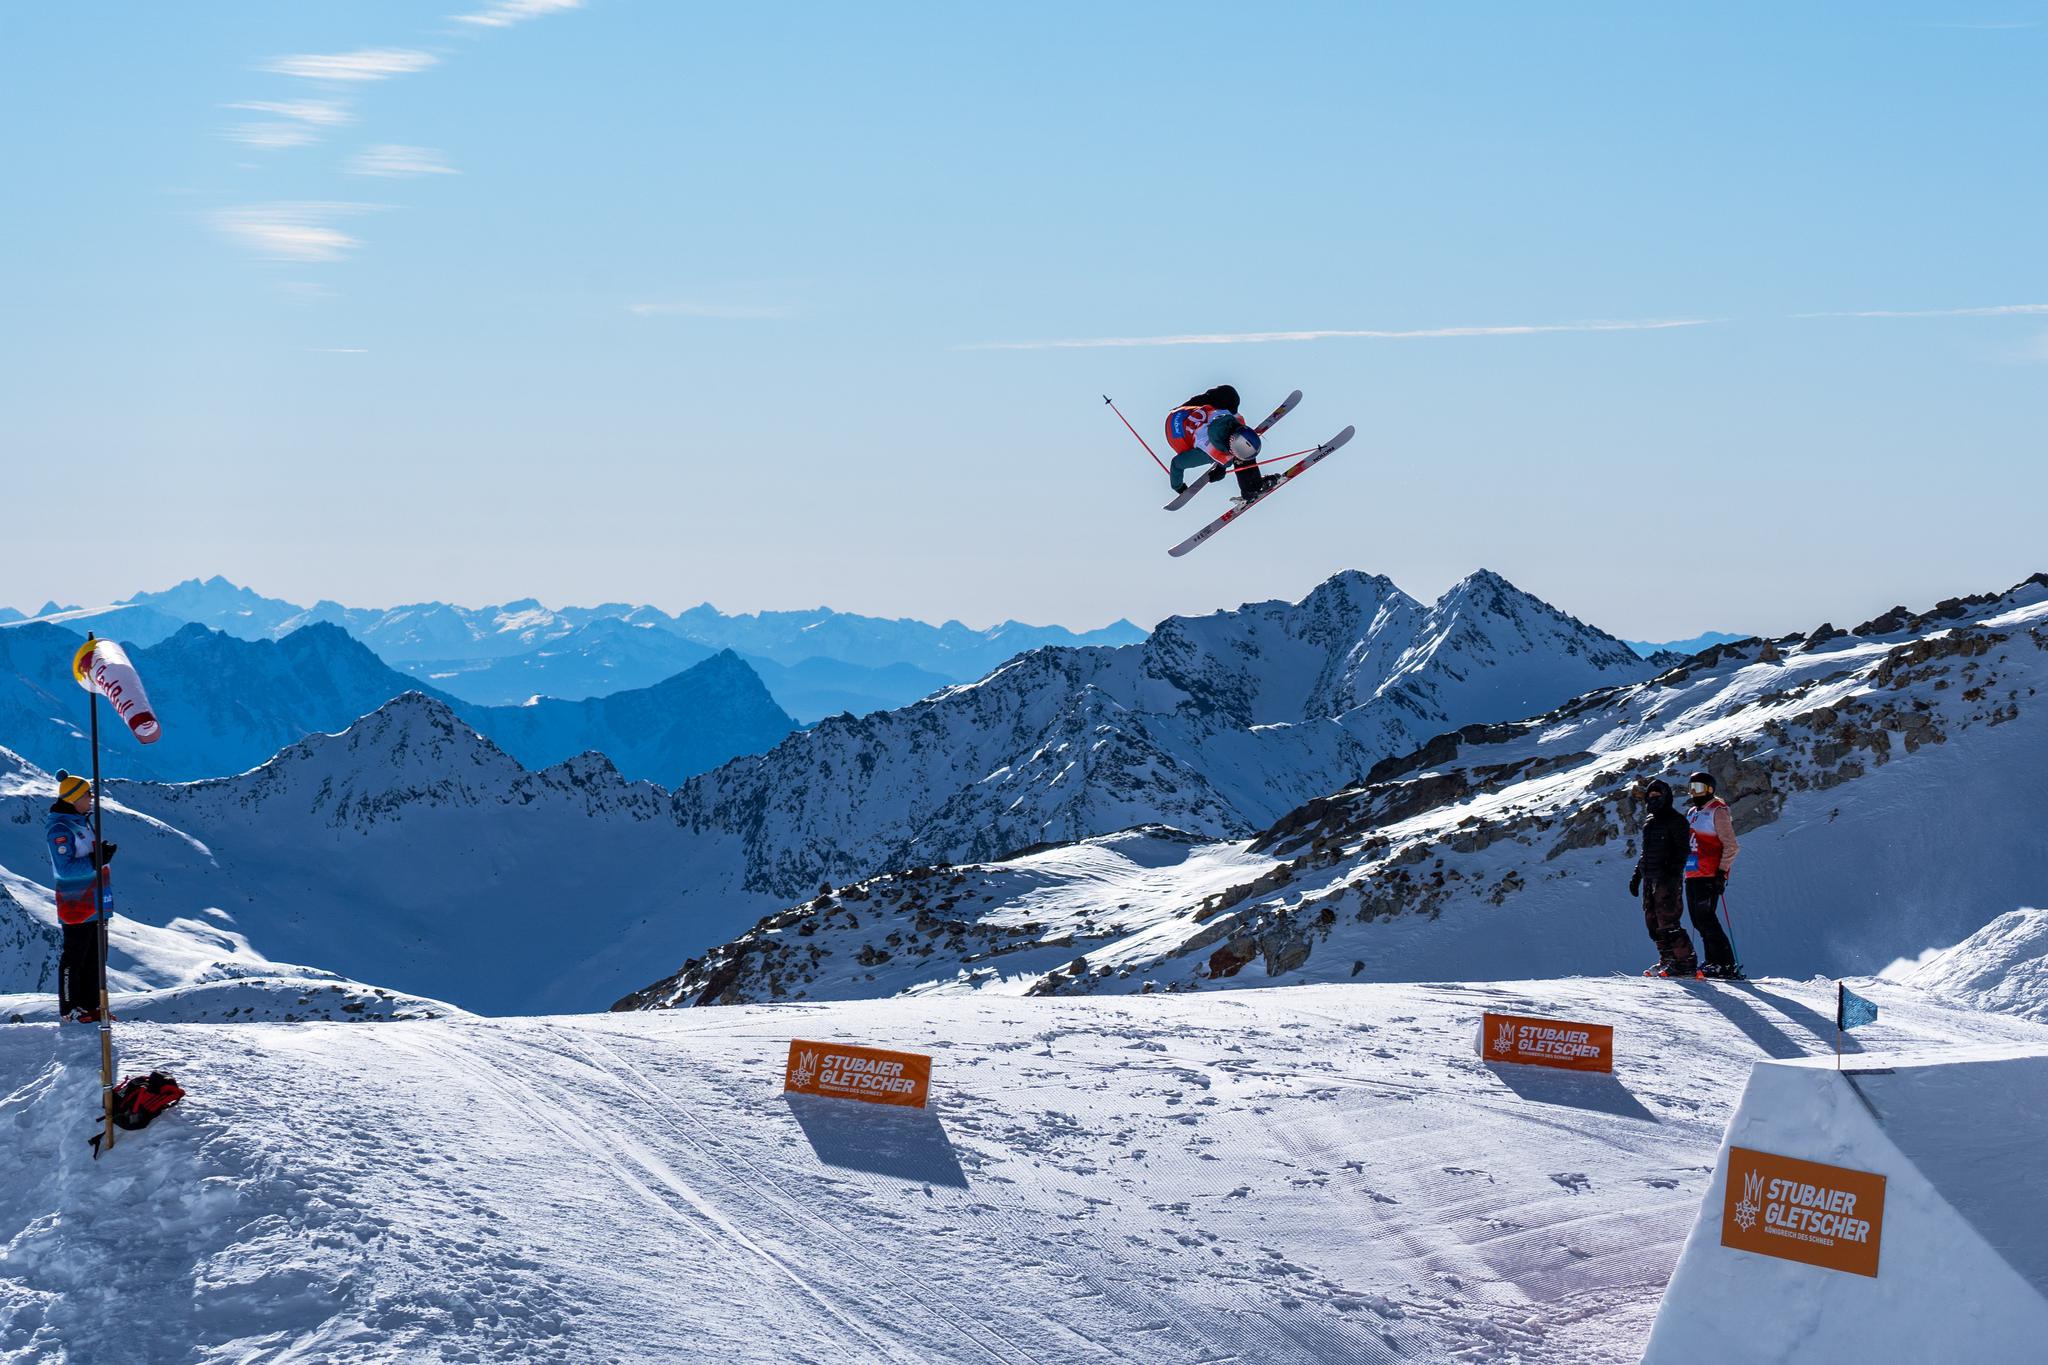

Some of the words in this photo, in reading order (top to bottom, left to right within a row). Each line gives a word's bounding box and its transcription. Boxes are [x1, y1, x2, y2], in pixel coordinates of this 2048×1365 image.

[1518, 1025, 1589, 1045] STUBAIER
[1518, 1038, 1601, 1058] GLETSCHER
[821, 1054, 904, 1077] STUBAIER
[818, 1069, 916, 1094] GLETSCHER
[1766, 1178, 1857, 1216] STUBAIER
[1764, 1202, 1871, 1243] GLETSCHER
[1797, 1233, 1808, 1241] DES
